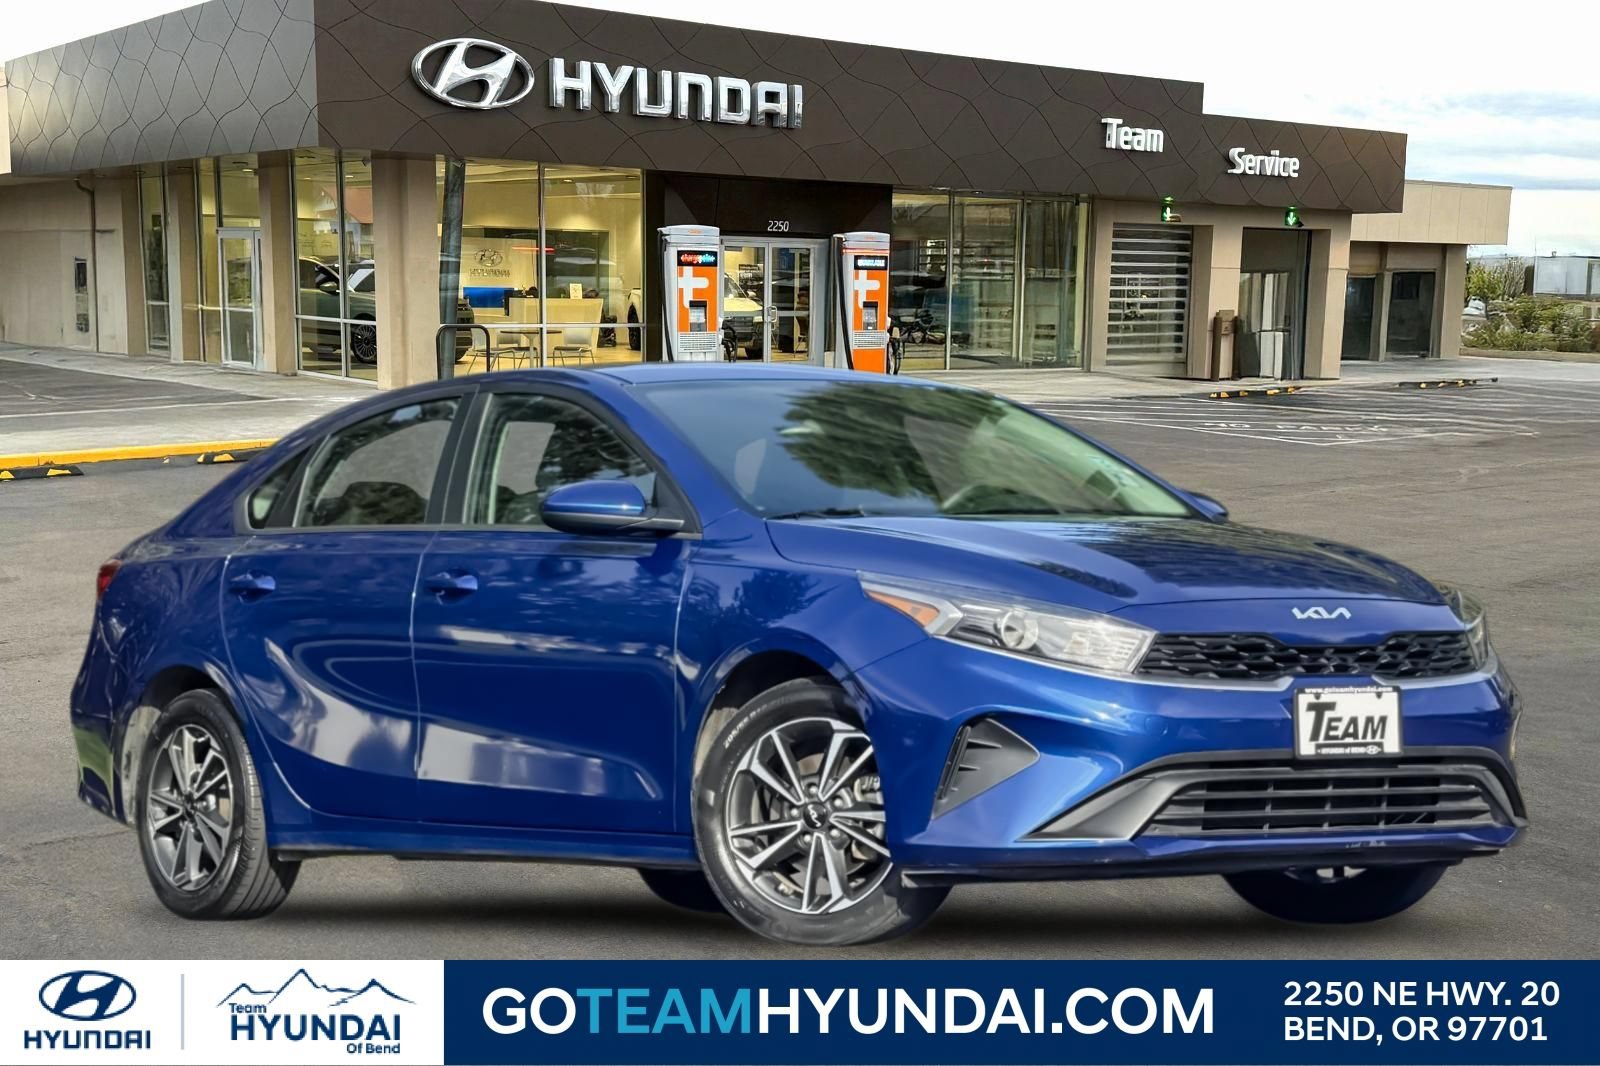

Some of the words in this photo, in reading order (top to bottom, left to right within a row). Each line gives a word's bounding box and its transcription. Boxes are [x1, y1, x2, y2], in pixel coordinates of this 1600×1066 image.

[549, 57, 804, 129] HYUNDAI
[1101, 117, 1165, 153] Team
[1227, 147, 1300, 178] Service
[767, 220, 790, 232] 2250
[1292, 606, 1352, 620] KIA
